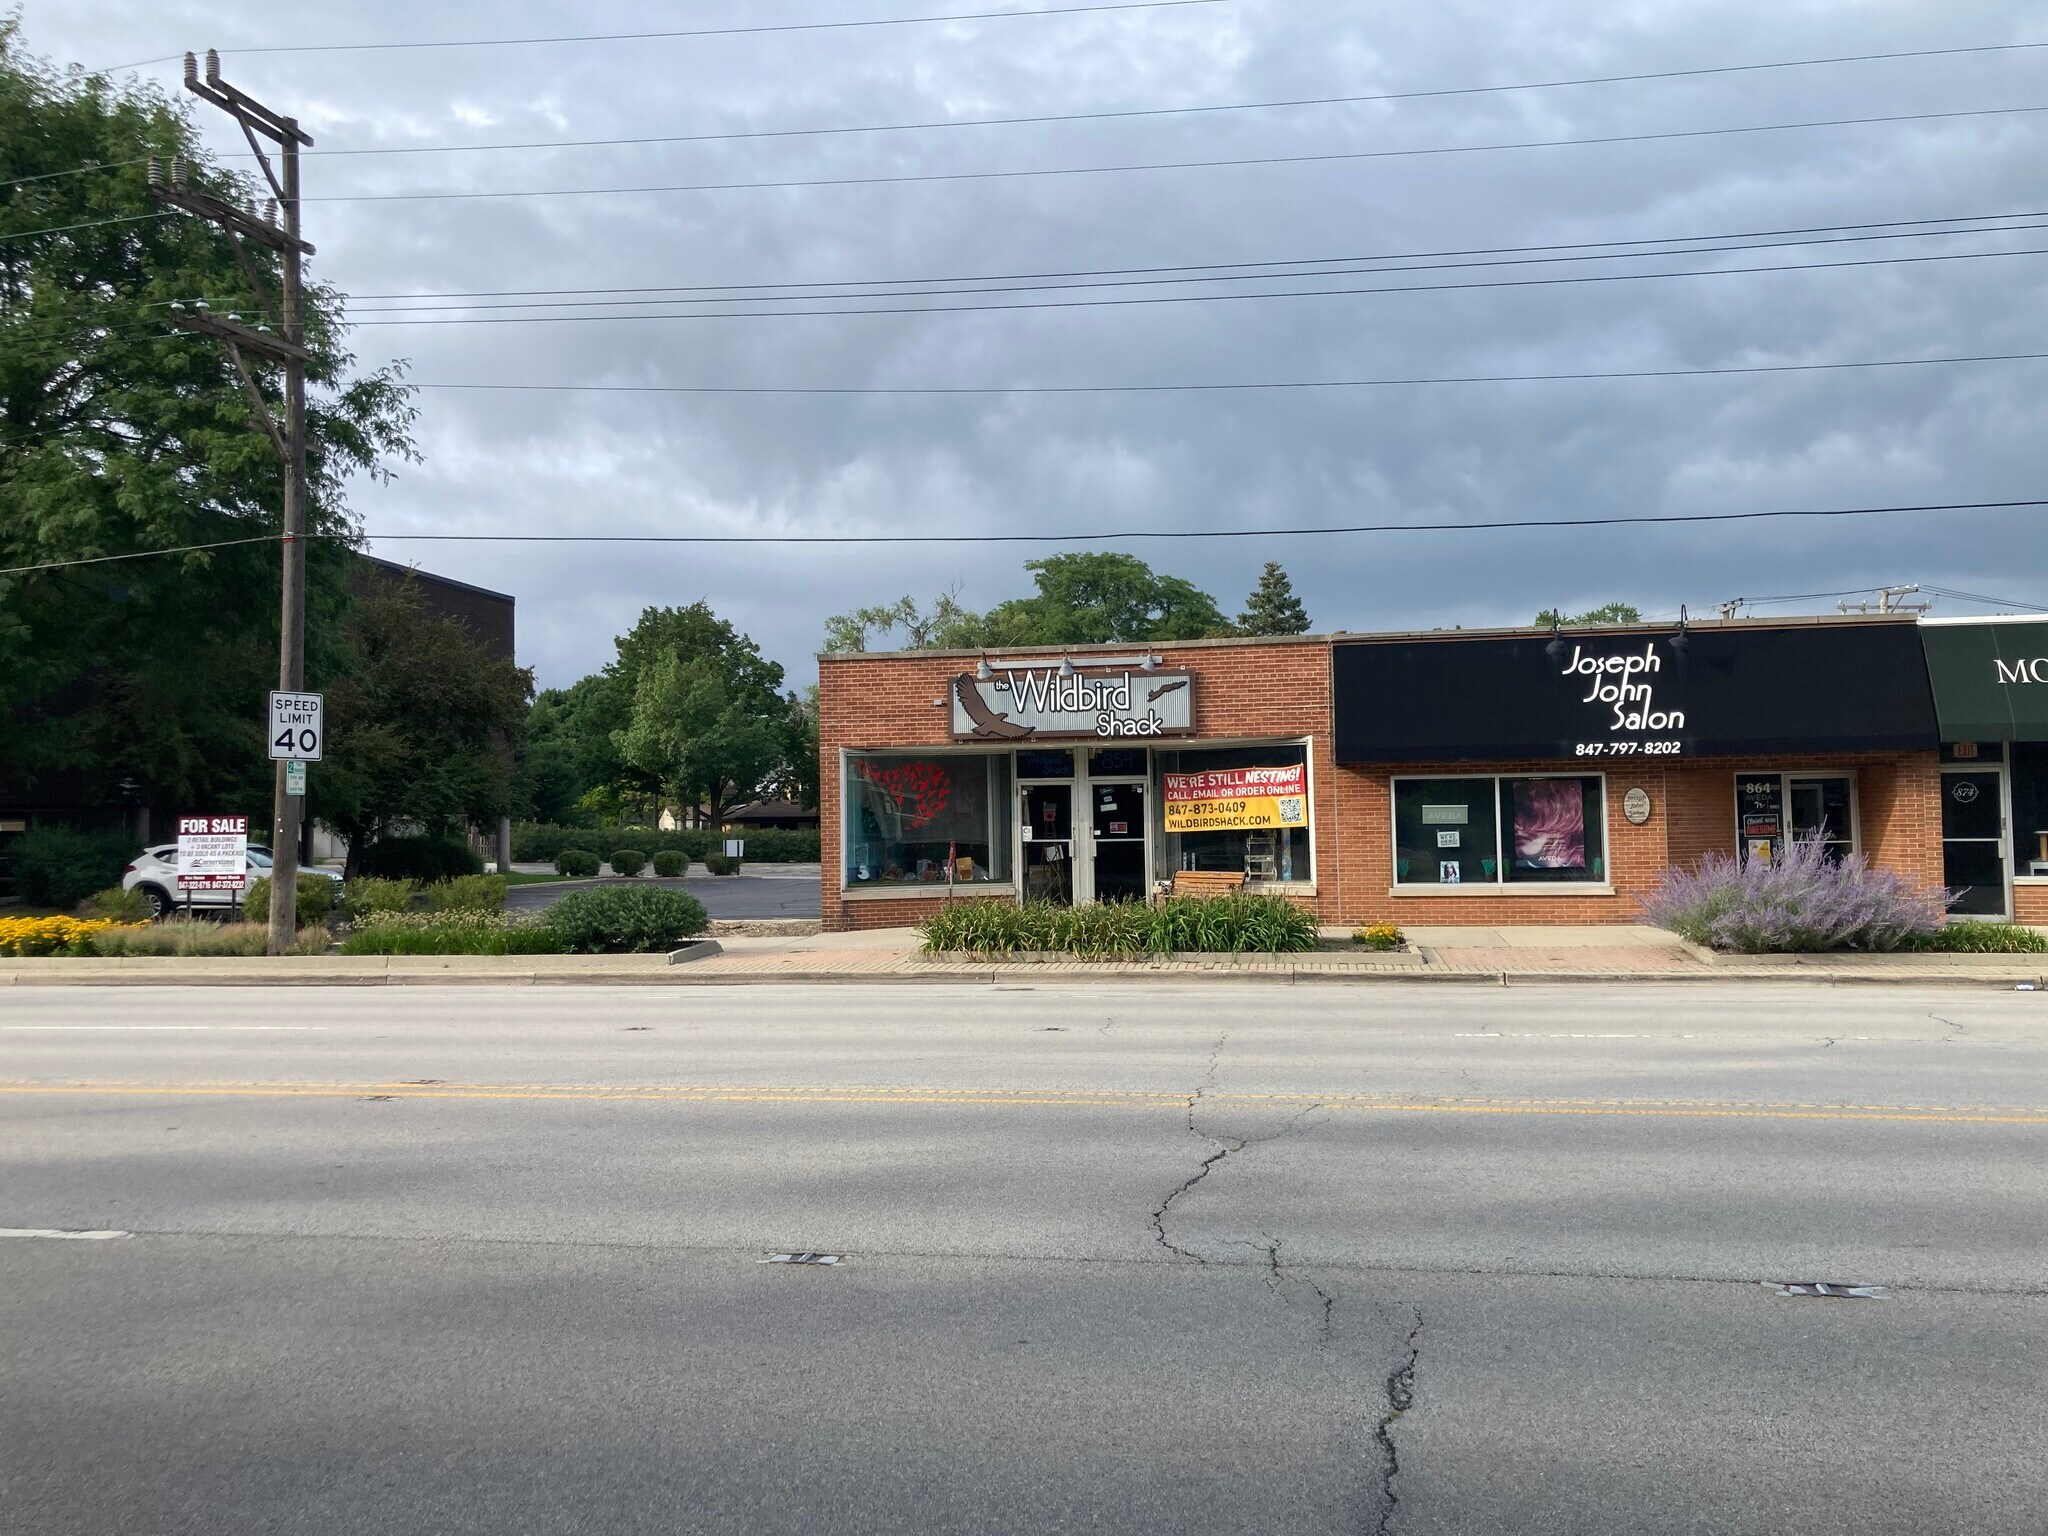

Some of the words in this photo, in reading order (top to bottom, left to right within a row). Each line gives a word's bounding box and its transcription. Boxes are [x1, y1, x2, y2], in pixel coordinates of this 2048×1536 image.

[1562, 643, 1661, 676] Joseph
[995, 680, 1010, 690] the
[1007, 669, 1130, 713] Wildbird
[1583, 673, 1652, 703] John
[275, 699, 318, 712] SPEED
[280, 713, 313, 724] LIMIT
[1096, 709, 1162, 736] Shack
[1610, 700, 1685, 730] Salon
[274, 728, 317, 752] 40
[1575, 741, 1681, 756] 847-797-8202
[288, 762, 294, 773] 2
[1102, 752, 1134, 769] 854
[1043, 765, 1070, 775] Shack
[1167, 775, 1205, 789] WE'RE
[1208, 772, 1244, 786] STILL
[1245, 767, 1301, 784] NESTING!
[1168, 791, 1191, 800] CALL,
[1193, 789, 1218, 799] EMAIL
[1221, 788, 1234, 797] OR
[1236, 786, 1265, 796] ORDER
[1266, 784, 1301, 795] ONLINE
[1746, 782, 1771, 793] 864
[1956, 788, 1974, 797] 874
[1168, 802, 1246, 815] 847-873-0409
[1428, 812, 1462, 820] AVEDA
[180, 819, 208, 833] FOR
[211, 818, 245, 833] SALE
[1168, 816, 1271, 828] WILDBIRDSHACK.COM
